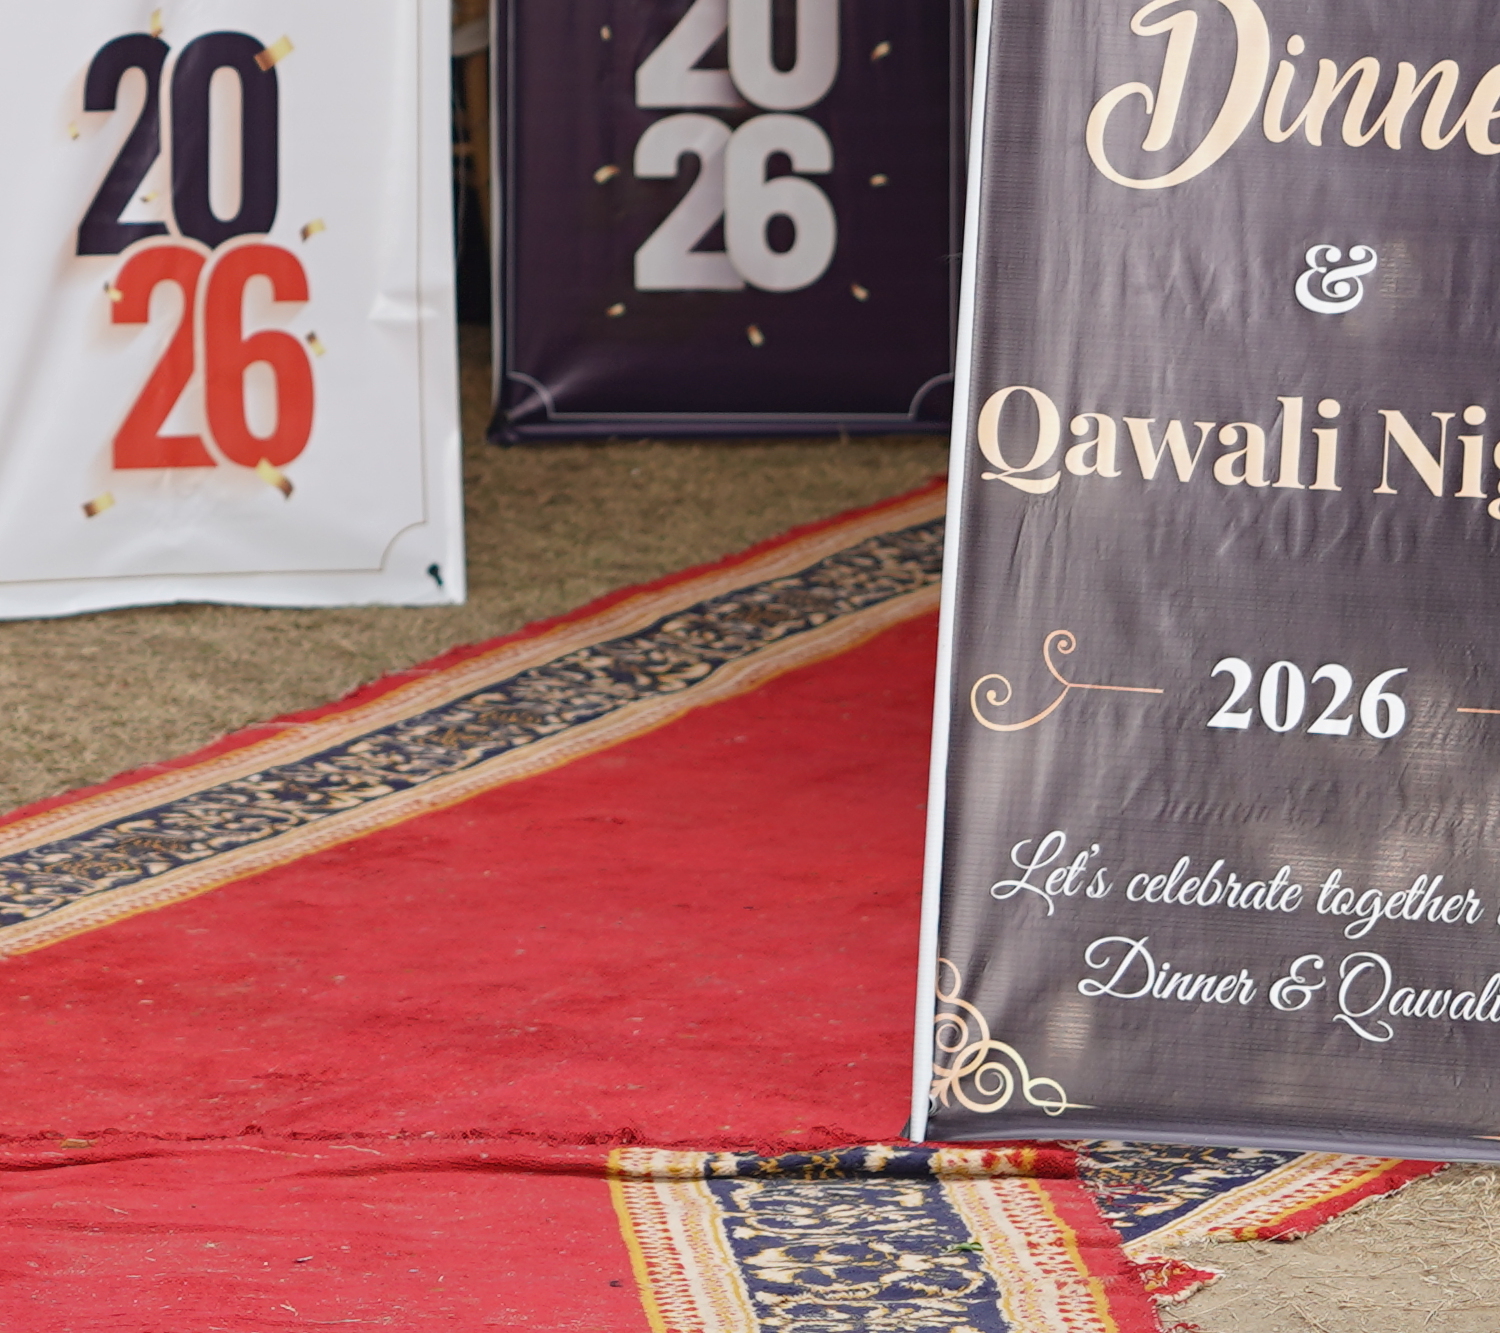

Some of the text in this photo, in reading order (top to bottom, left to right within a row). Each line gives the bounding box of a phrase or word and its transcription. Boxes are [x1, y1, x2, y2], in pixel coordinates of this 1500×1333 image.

[1295, 244, 1377, 314] &
[977, 385, 1342, 494] Qawali
[1207, 657, 1408, 738] 2026
[990, 830, 1110, 916] Let's
[1126, 856, 1303, 913] celebrate
[1318, 869, 1484, 939] together
[1078, 935, 1256, 1006] Dinner
[1269, 955, 1325, 1011] &
